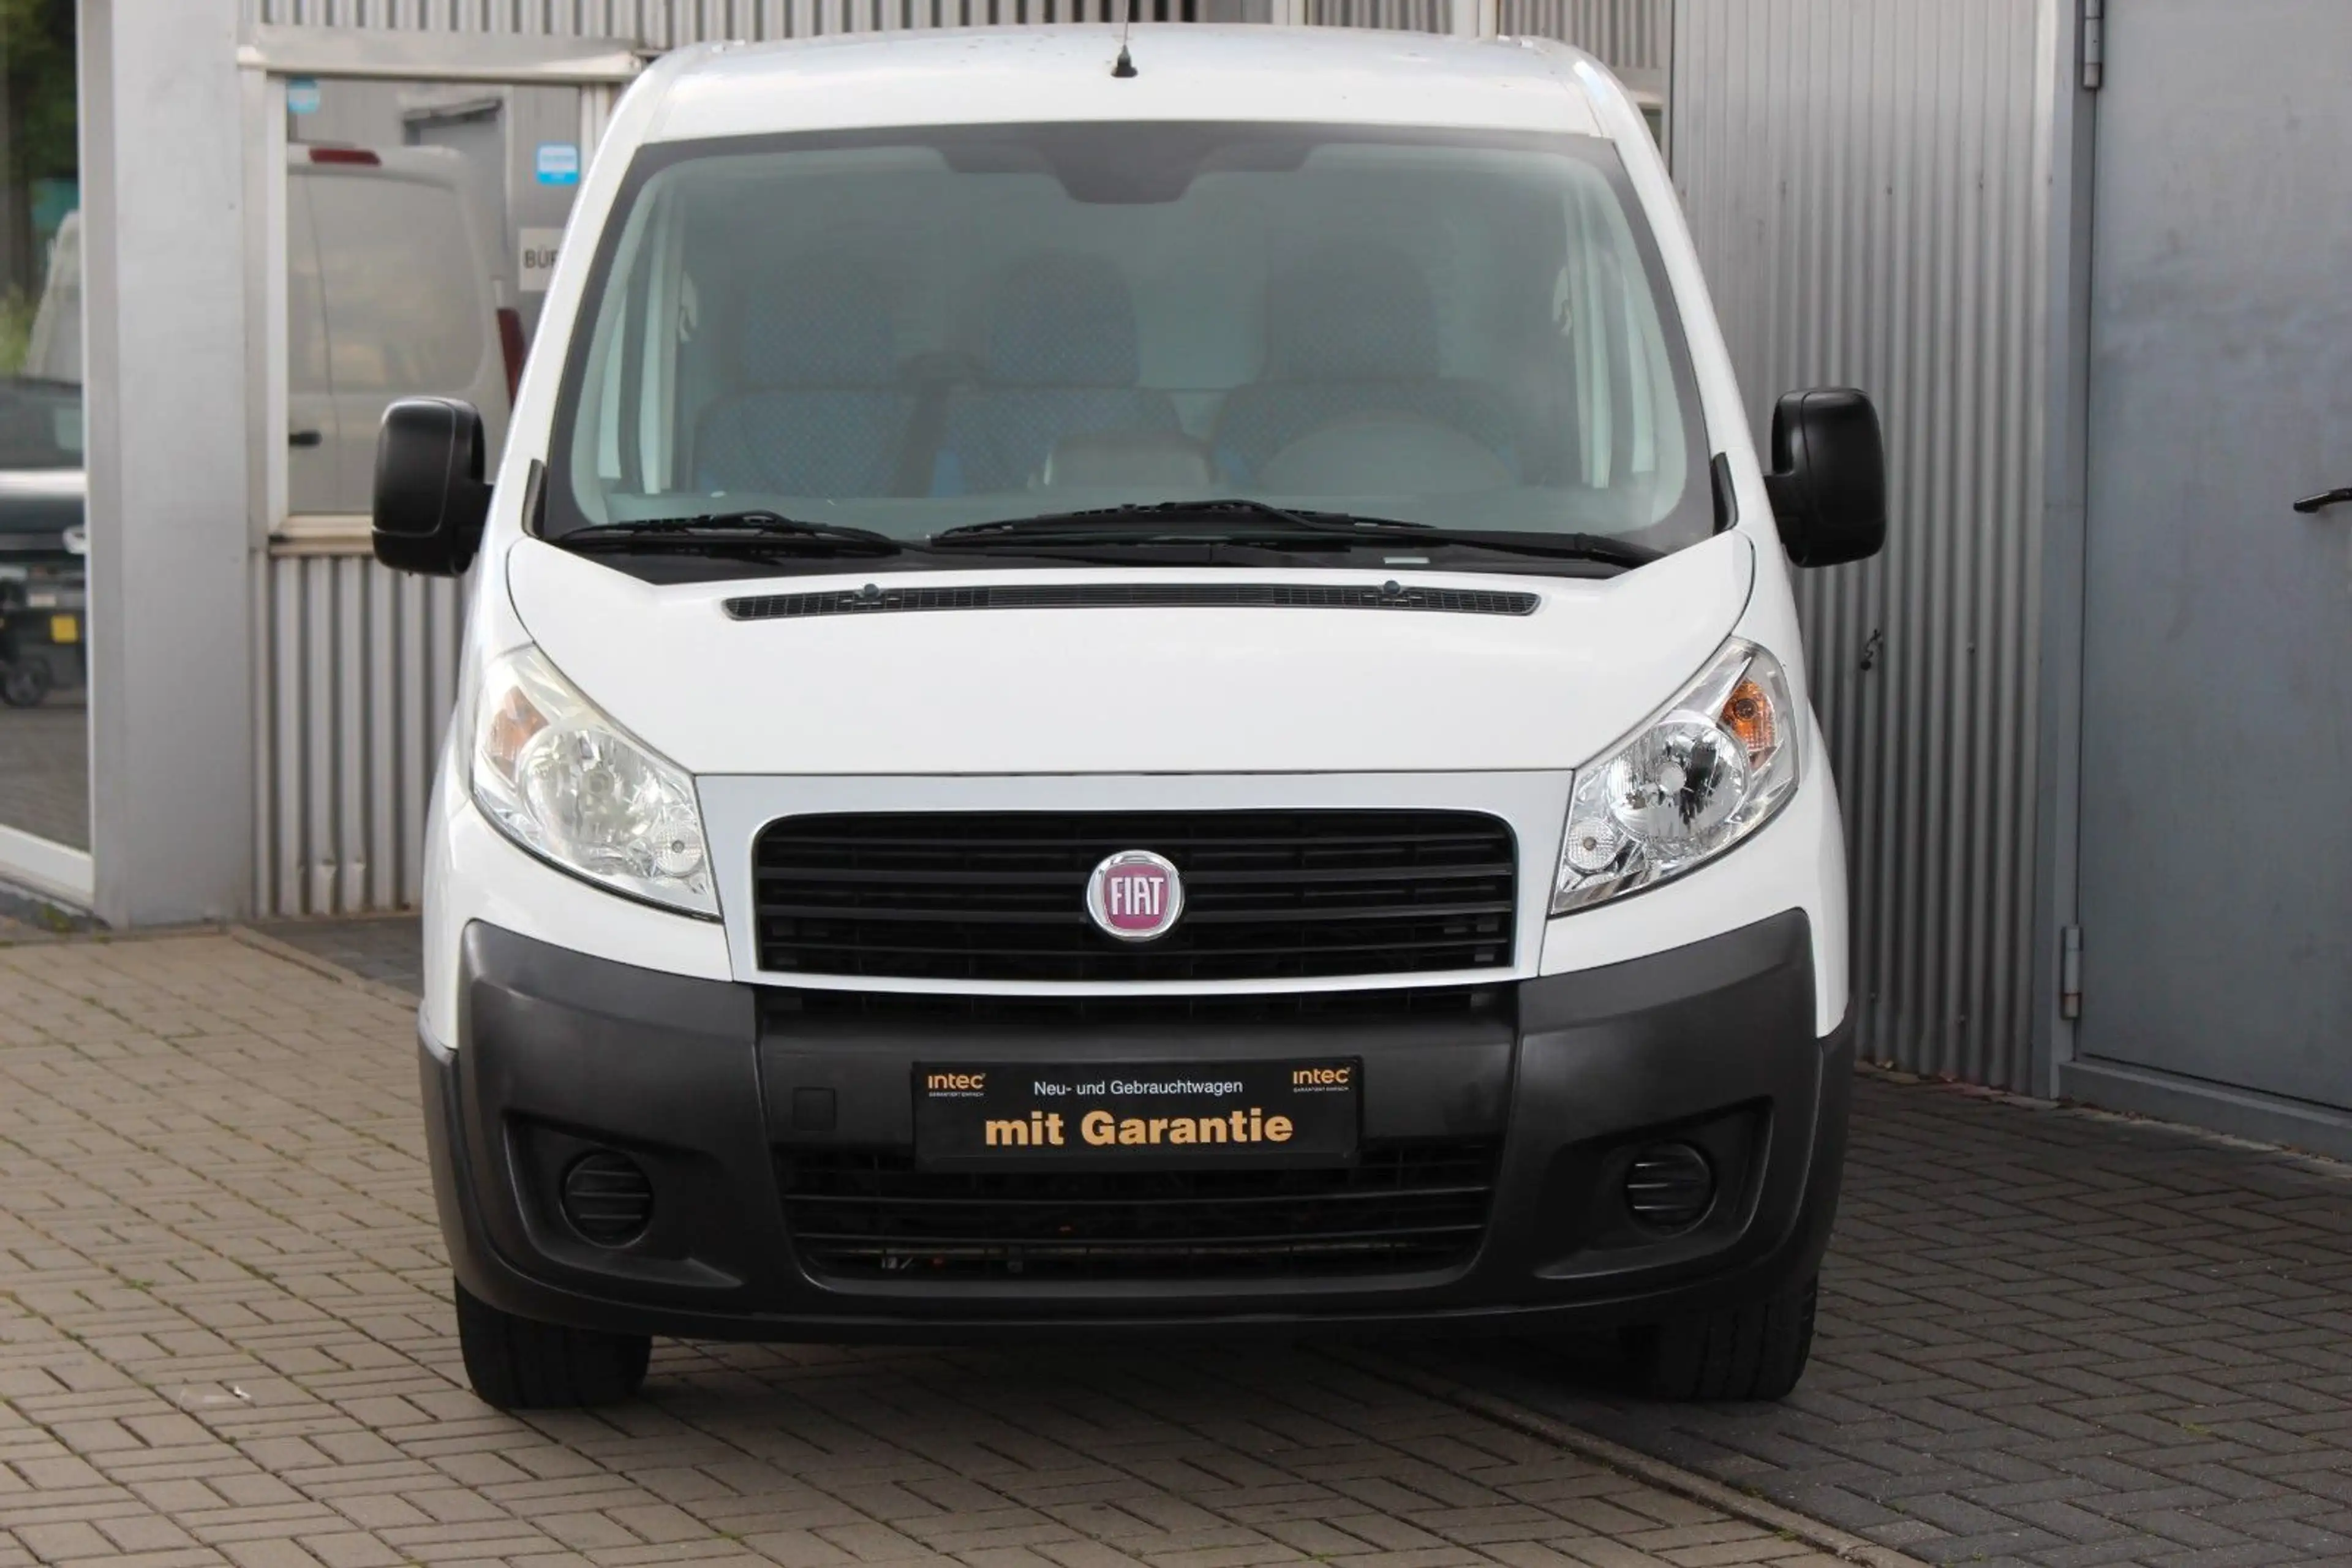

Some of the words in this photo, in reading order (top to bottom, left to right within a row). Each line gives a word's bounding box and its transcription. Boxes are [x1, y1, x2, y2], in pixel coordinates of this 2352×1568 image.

[1110, 876, 1164, 916] FIAT
[927, 1072, 984, 1089] intec
[1292, 1068, 1349, 1084] intec
[1034, 1081, 1072, 1096] Neu-
[1076, 1080, 1106, 1095] und
[1110, 1080, 1243, 1097] Gebrauchtwagen
[986, 1110, 1065, 1146] mit
[1080, 1107, 1294, 1145] Garantie
